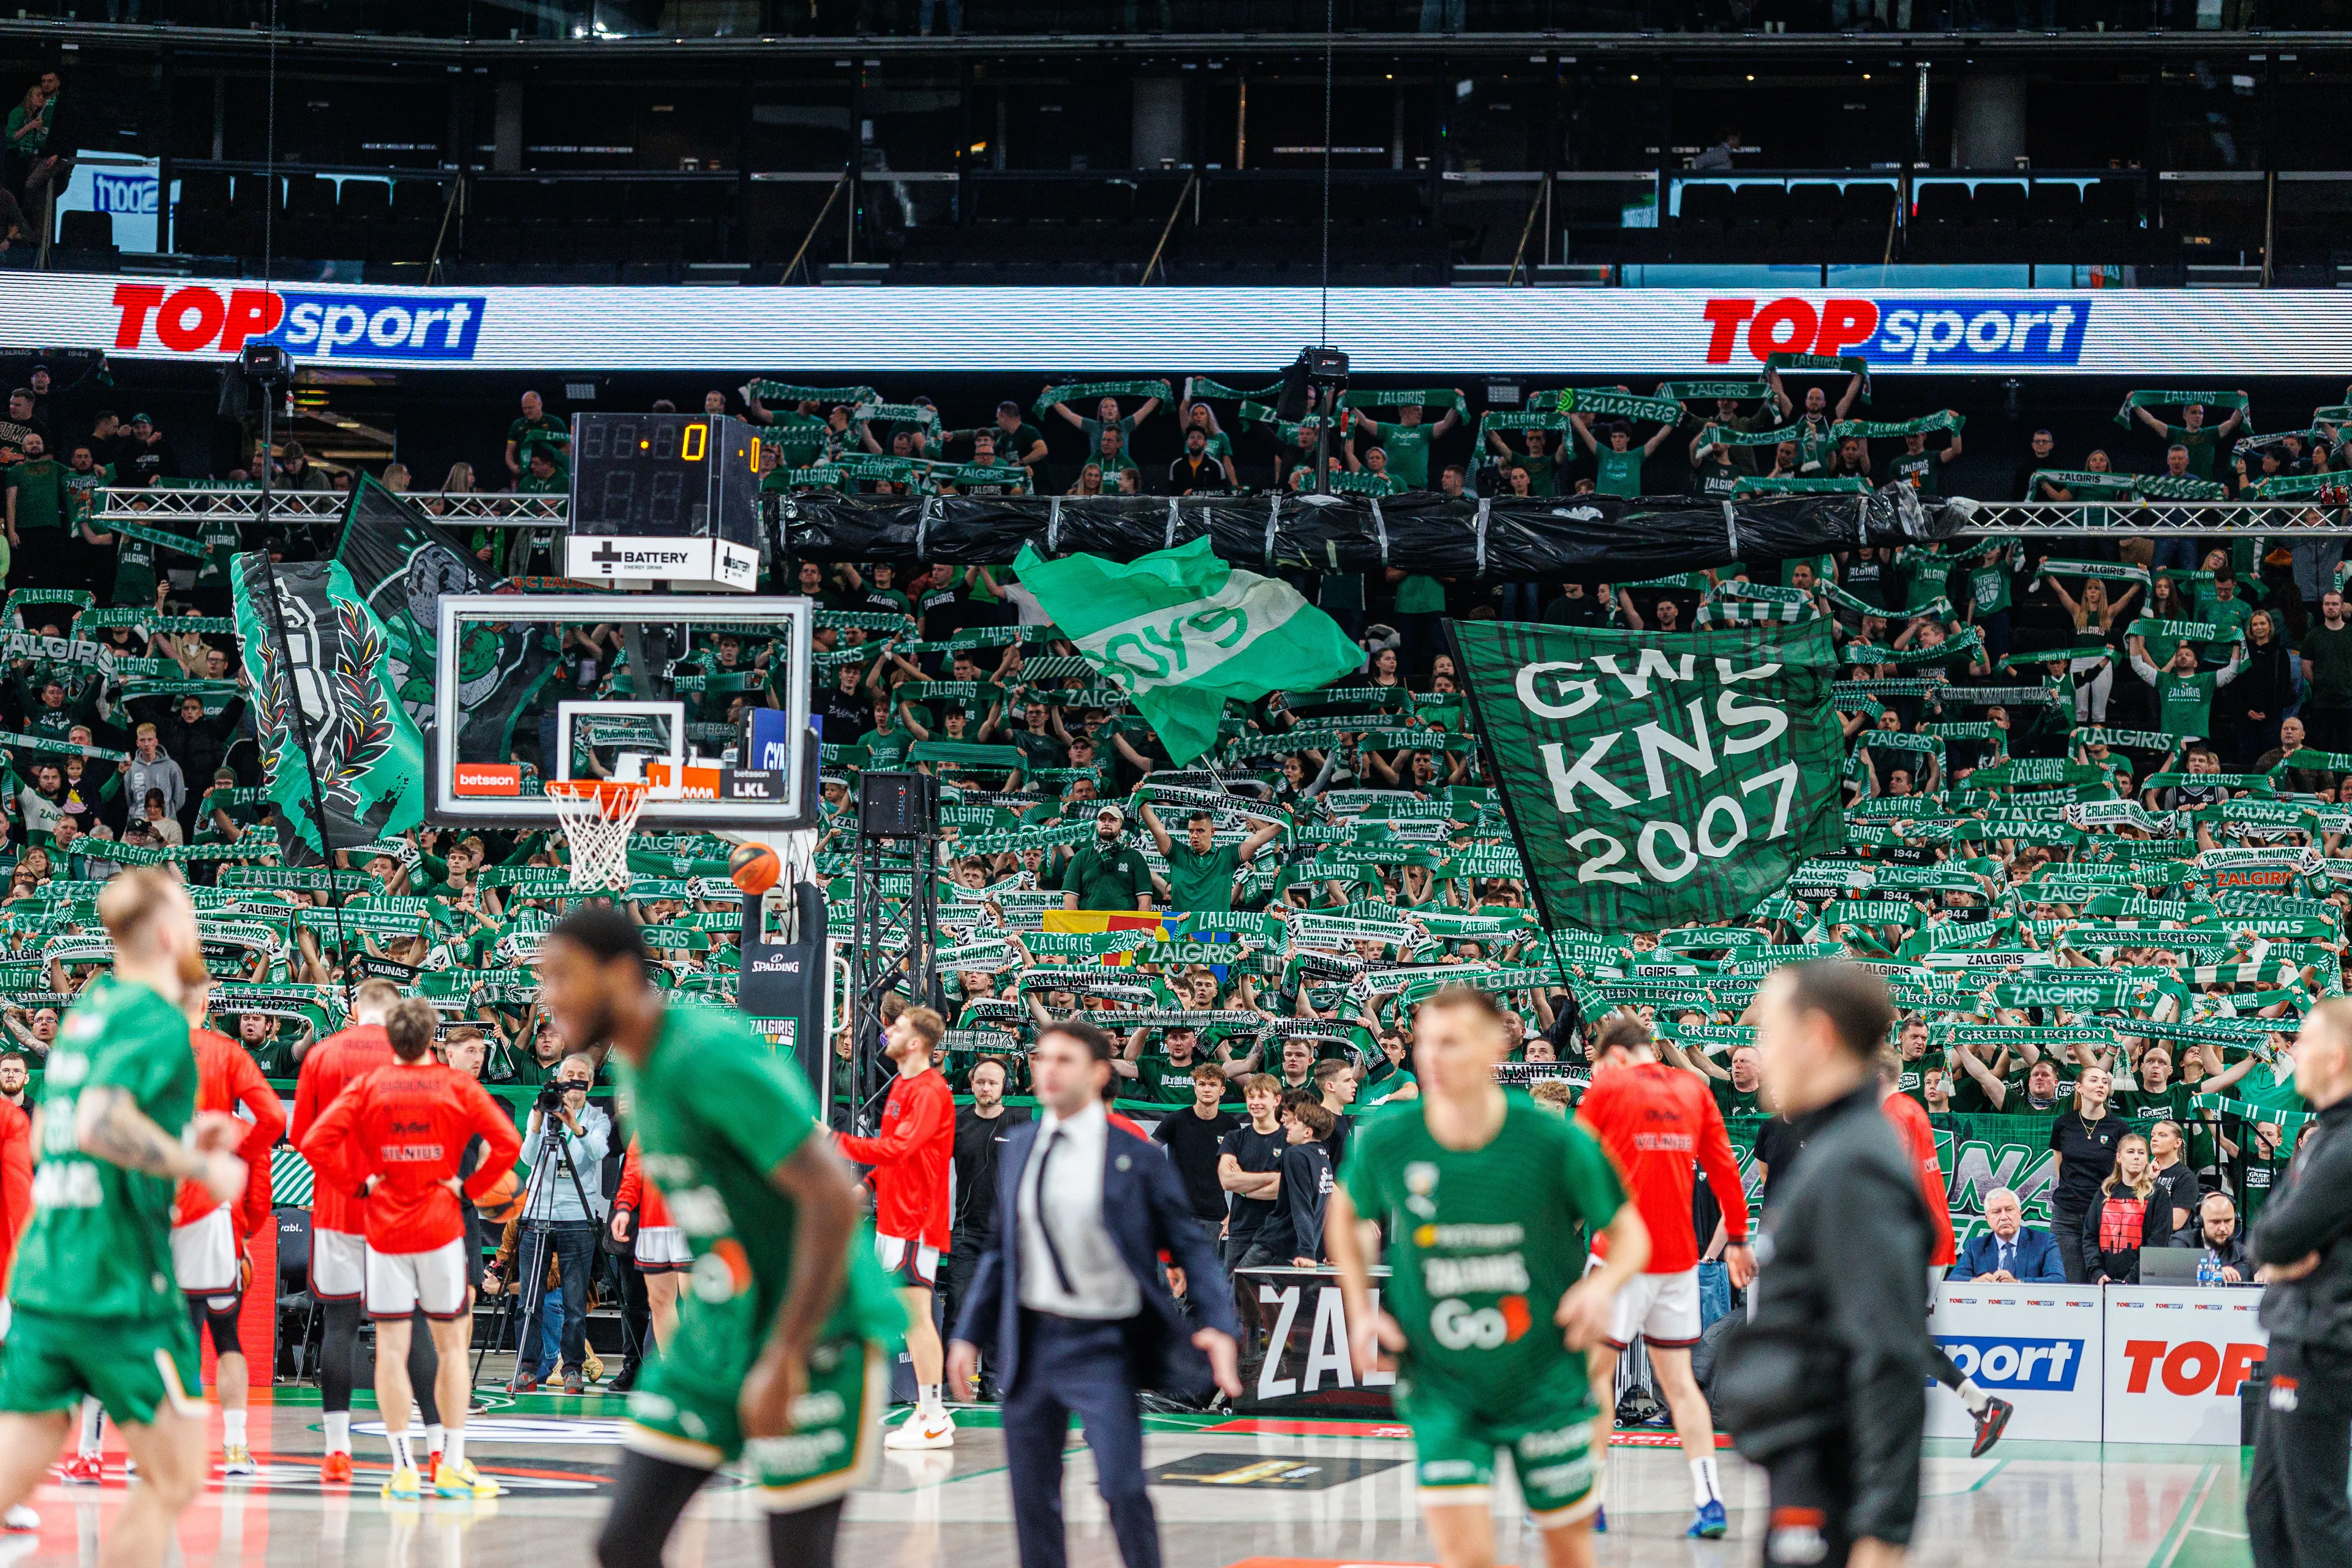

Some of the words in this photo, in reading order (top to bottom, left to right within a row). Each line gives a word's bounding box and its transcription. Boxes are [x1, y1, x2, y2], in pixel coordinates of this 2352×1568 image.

[682, 424, 707, 461] 0
[624, 552, 687, 564] BATTERY
[1538, 696, 1789, 813] KNS
[460, 774, 514, 786] betsson
[734, 769, 769, 778] betsson
[734, 783, 768, 796] LKL
[1155, 788, 1198, 804] GREEN
[1202, 796, 1245, 810] WHITE
[1248, 804, 1283, 818] BOYS
[2011, 789, 2077, 806] KAUNAS
[2086, 804, 2126, 816] ŽALGIRIS
[2223, 807, 2302, 823] KAUNAS
[1566, 760, 1798, 885] 2007
[1981, 822, 2065, 839] KAUNAS
[1894, 849, 1920, 859] 1944
[2204, 850, 2253, 866] ŽALGIRIS
[2258, 849, 2303, 860] KAUNAS
[1796, 888, 1838, 897] KAUNAS
[1883, 891, 1910, 901] 1944
[1302, 916, 1356, 932] ŽALGIRIS
[1359, 922, 1406, 936] KAUNAS
[2222, 921, 2304, 933] KAUNAS
[2084, 932, 2141, 943] GREEN
[2146, 932, 2212, 944] LEGION
[752, 961, 799, 973] SPALDING
[1303, 954, 1346, 971] GREEN
[368, 963, 409, 978] KAUNAS
[1027, 974, 1068, 987] GREEN
[1120, 974, 1156, 988] BOYS
[1370, 970, 1428, 988] ŽALGIRIS
[1648, 987, 1706, 1003] LEGION
[1894, 993, 1961, 1006] LEGION
[1150, 1011, 1208, 1021] WHITE
[1212, 1011, 1259, 1024] BOYS
[1275, 1020, 1316, 1035] WHITE
[1317, 1024, 1352, 1038] BOYS
[1678, 1024, 1740, 1038] GREEN
[1958, 1030, 2027, 1041] GREEN
[2031, 1029, 2108, 1040] LEGION
[2101, 1019, 2170, 1036] GREEN
[2176, 1028, 2252, 1044] LEGION
[973, 1030, 1016, 1048] BOYS
[1515, 1065, 1556, 1079] WHITE
[381, 1145, 442, 1161] VILNIUS
